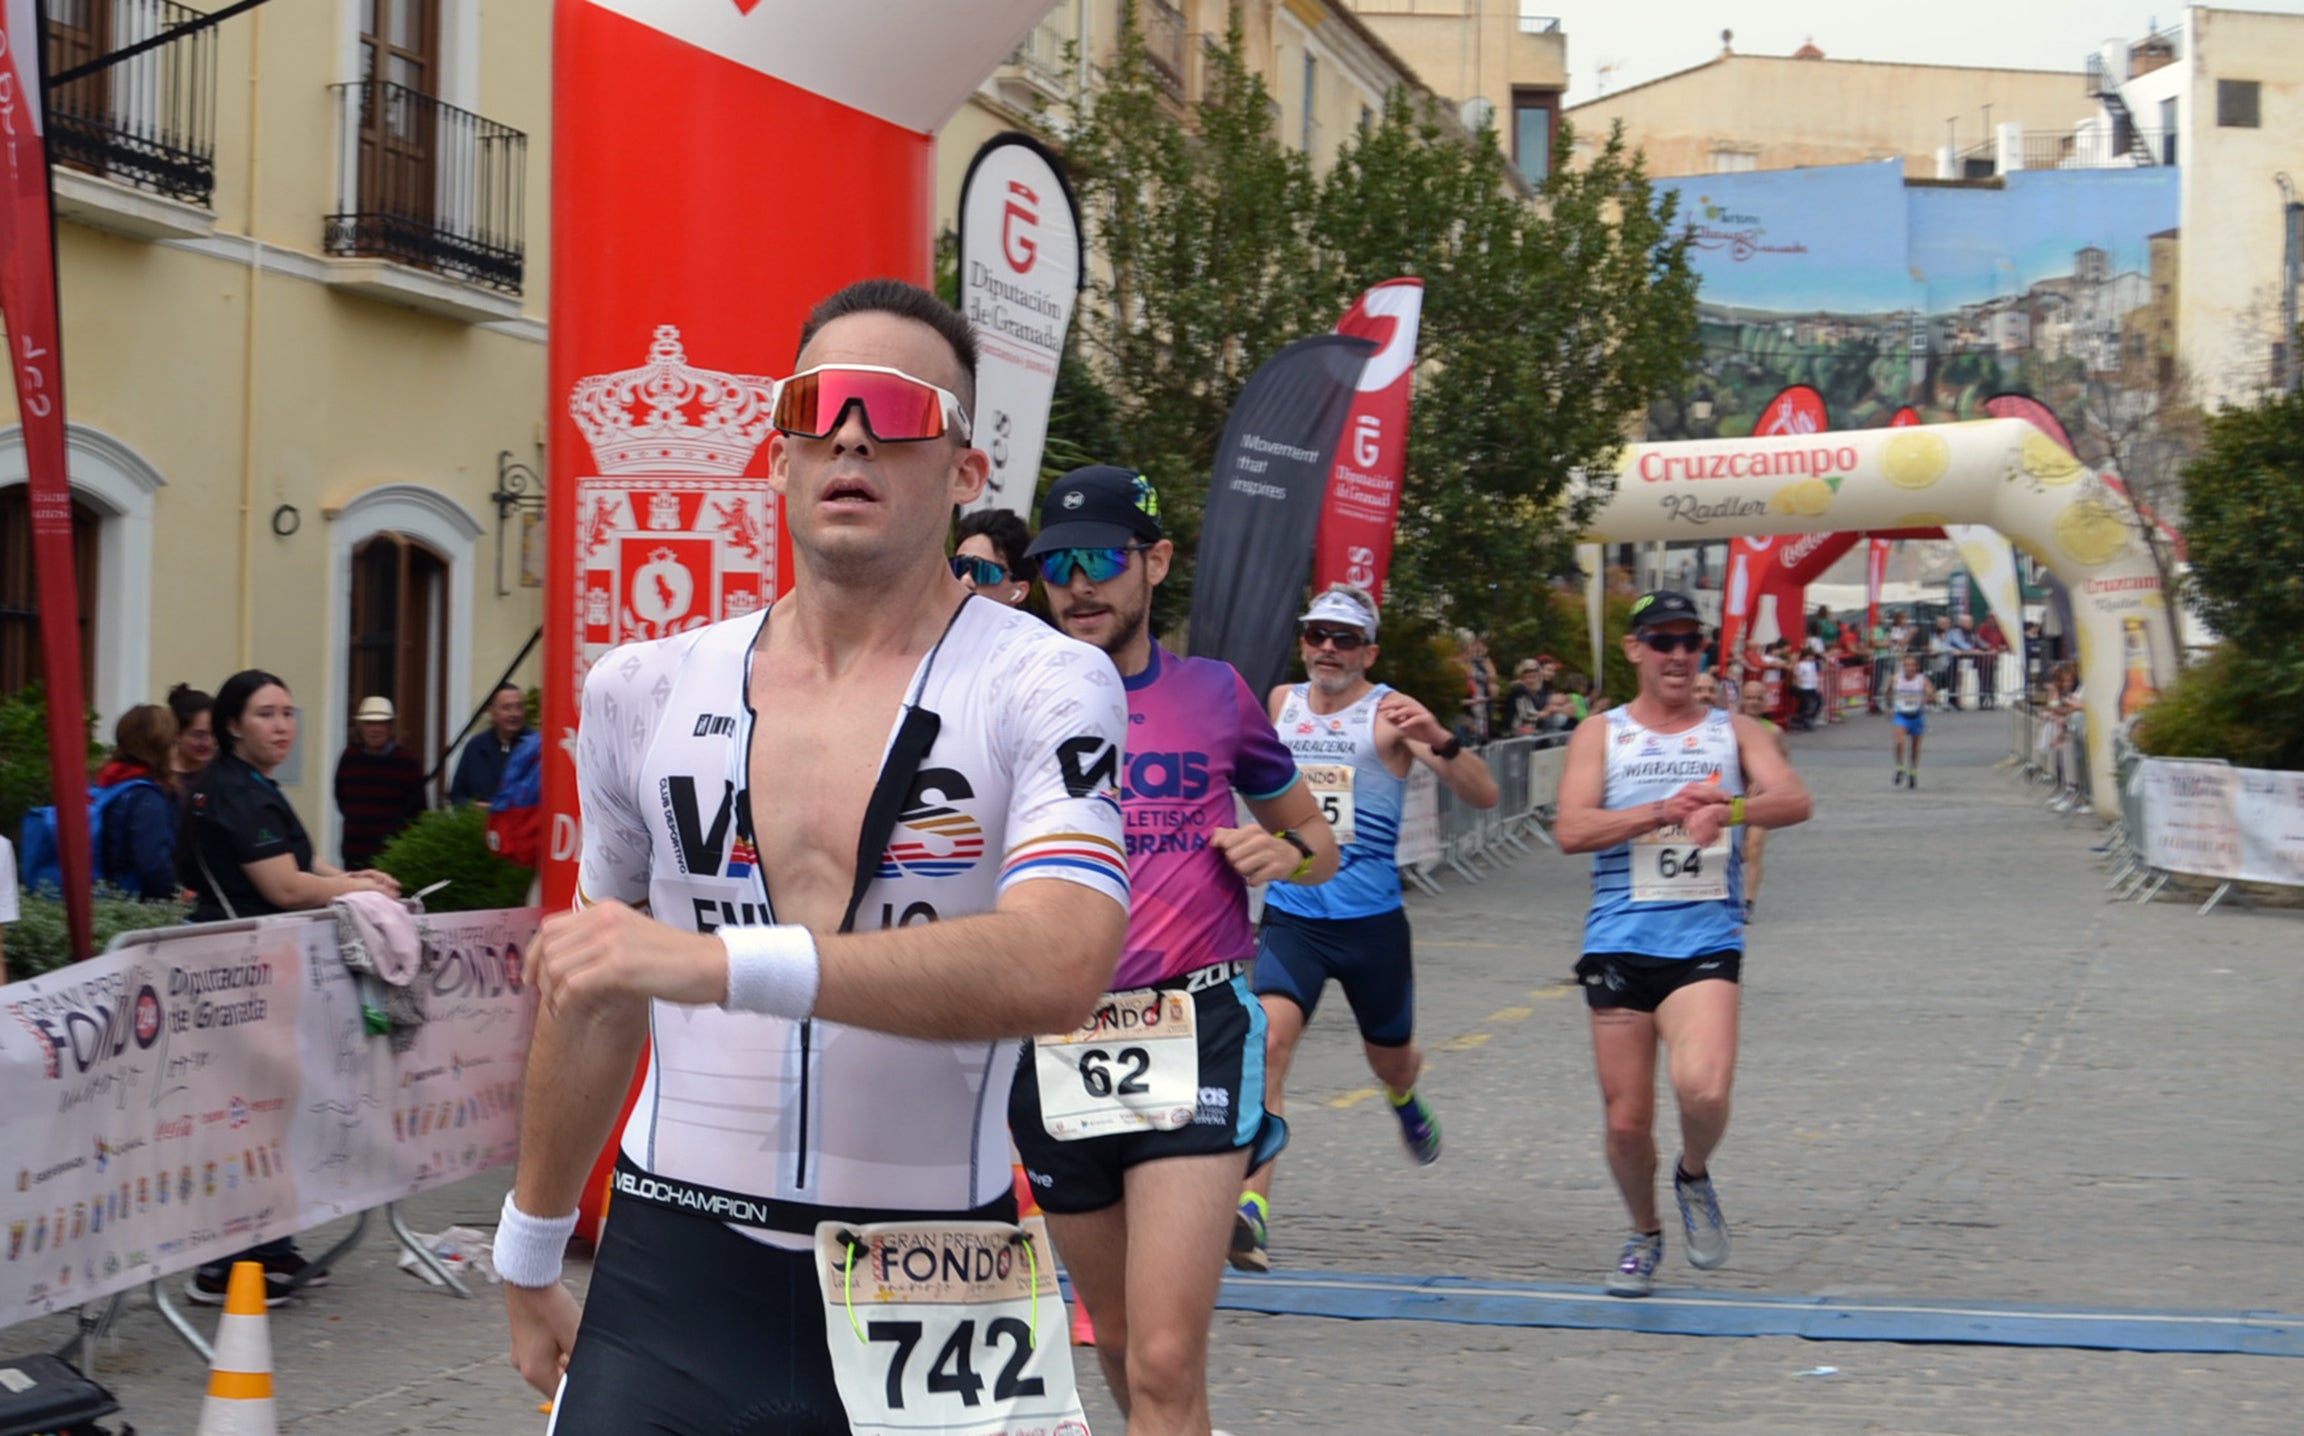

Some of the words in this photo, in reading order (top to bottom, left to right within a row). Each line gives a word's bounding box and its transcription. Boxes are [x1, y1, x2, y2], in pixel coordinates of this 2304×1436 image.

[970, 260, 1062, 321] Diputación
[970, 296, 991, 326] de
[993, 305, 1061, 352] Granada
[1235, 455, 1268, 474] that
[1240, 433, 1320, 464] Movement
[1639, 446, 1859, 483] Cruzcampo
[1229, 475, 1287, 500] inspires
[1660, 493, 1768, 525] Radler
[659, 777, 671, 808] CLUB
[1300, 772, 1337, 785] NDO
[1322, 796, 1340, 825] 5
[664, 809, 687, 875] DEPORTIVO
[1658, 847, 1704, 879] 64
[1079, 1046, 1151, 1098] 62
[616, 1170, 768, 1224] VELOCHAMPION
[881, 1232, 937, 1250] GRAN
[881, 1245, 1012, 1282] FONDO
[867, 1316, 1046, 1410] 742
